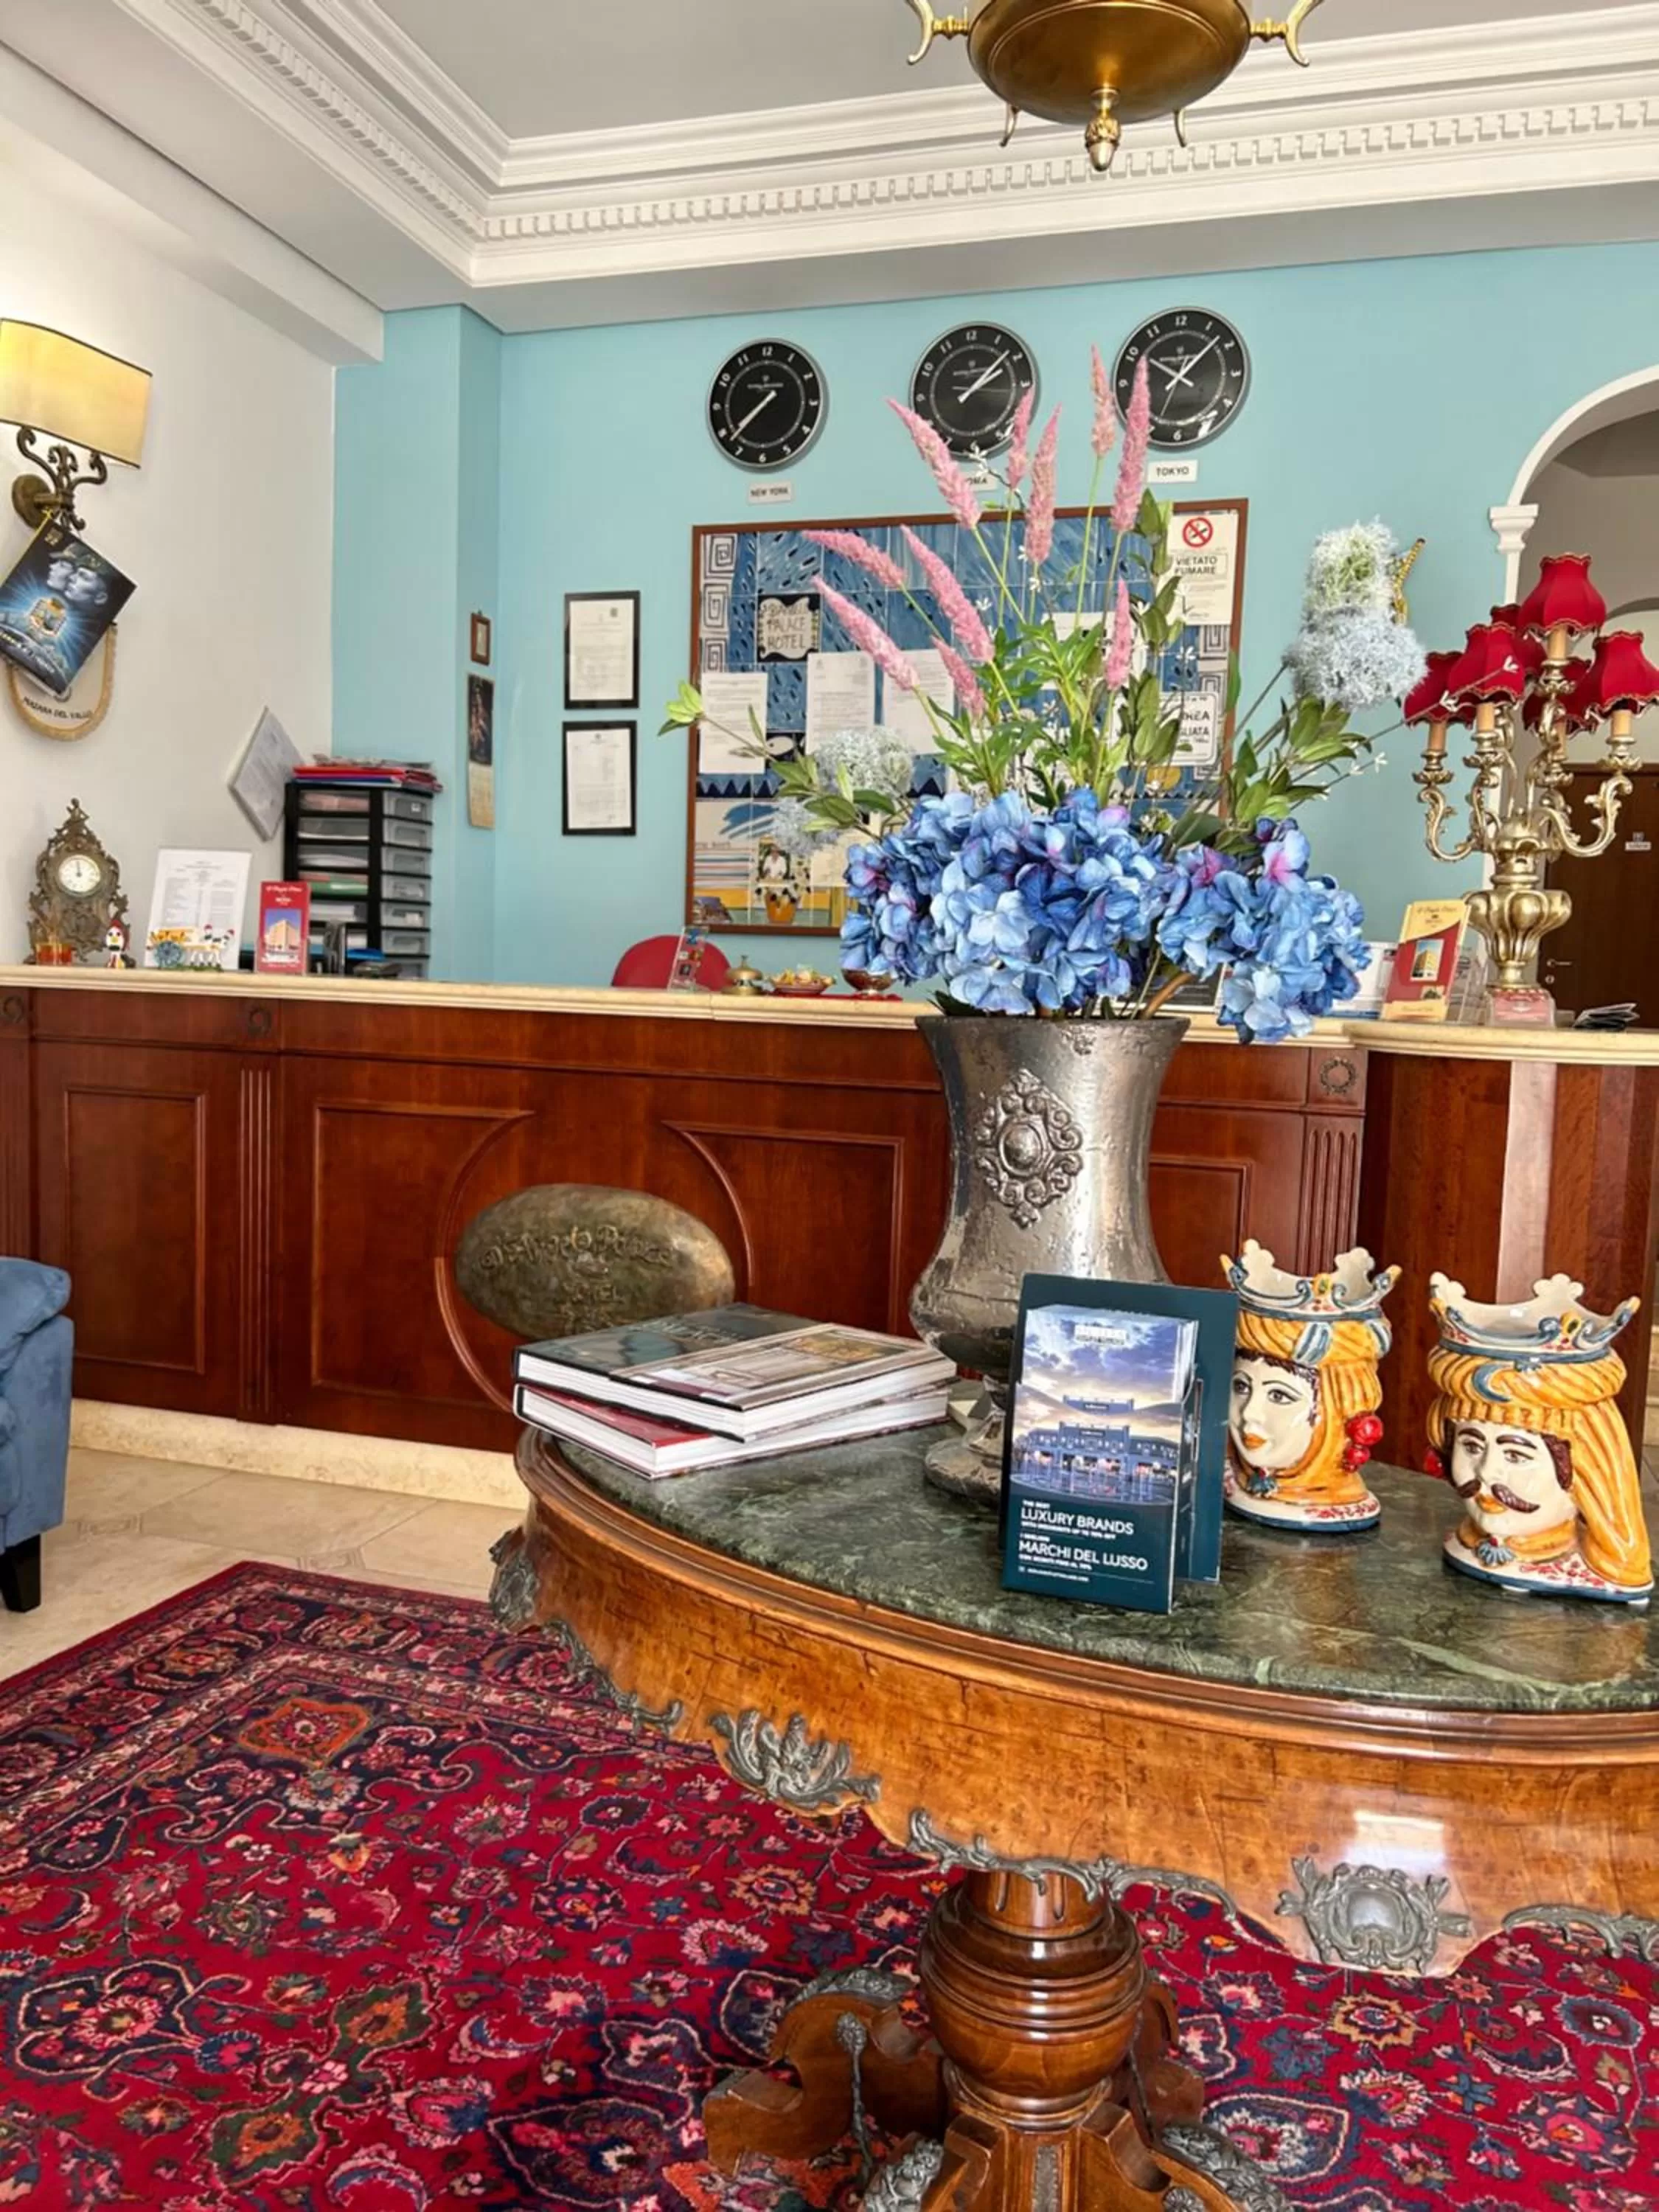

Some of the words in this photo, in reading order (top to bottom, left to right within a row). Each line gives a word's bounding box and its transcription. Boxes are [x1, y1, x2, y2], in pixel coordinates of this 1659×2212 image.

[1175, 315, 1188, 326] 12
[966, 330, 978, 341] 12
[1147, 324, 1160, 338] 11
[762, 346, 773, 357] 12
[939, 339, 953, 354] 11
[737, 353, 751, 366] 11
[1125, 346, 1139, 361] 10
[922, 361, 934, 377] 10
[718, 372, 731, 387] 10
[1173, 429, 1181, 441] 6
[759, 452, 767, 463] 6
[1155, 465, 1190, 478] TOKYO
[965, 476, 987, 484] OMA
[751, 488, 768, 497] NEW
[1176, 555, 1217, 566] VIETATO
[1175, 566, 1217, 576] FUMARE
[768, 634, 807, 649] HOTEL
[1021, 1507, 1075, 1526] LUXURY
[1077, 1514, 1134, 1536] BRANDS
[1018, 1540, 1071, 1559] MARCHI
[1073, 1548, 1100, 1565] DEL
[1102, 1551, 1148, 1572] LUSSO
